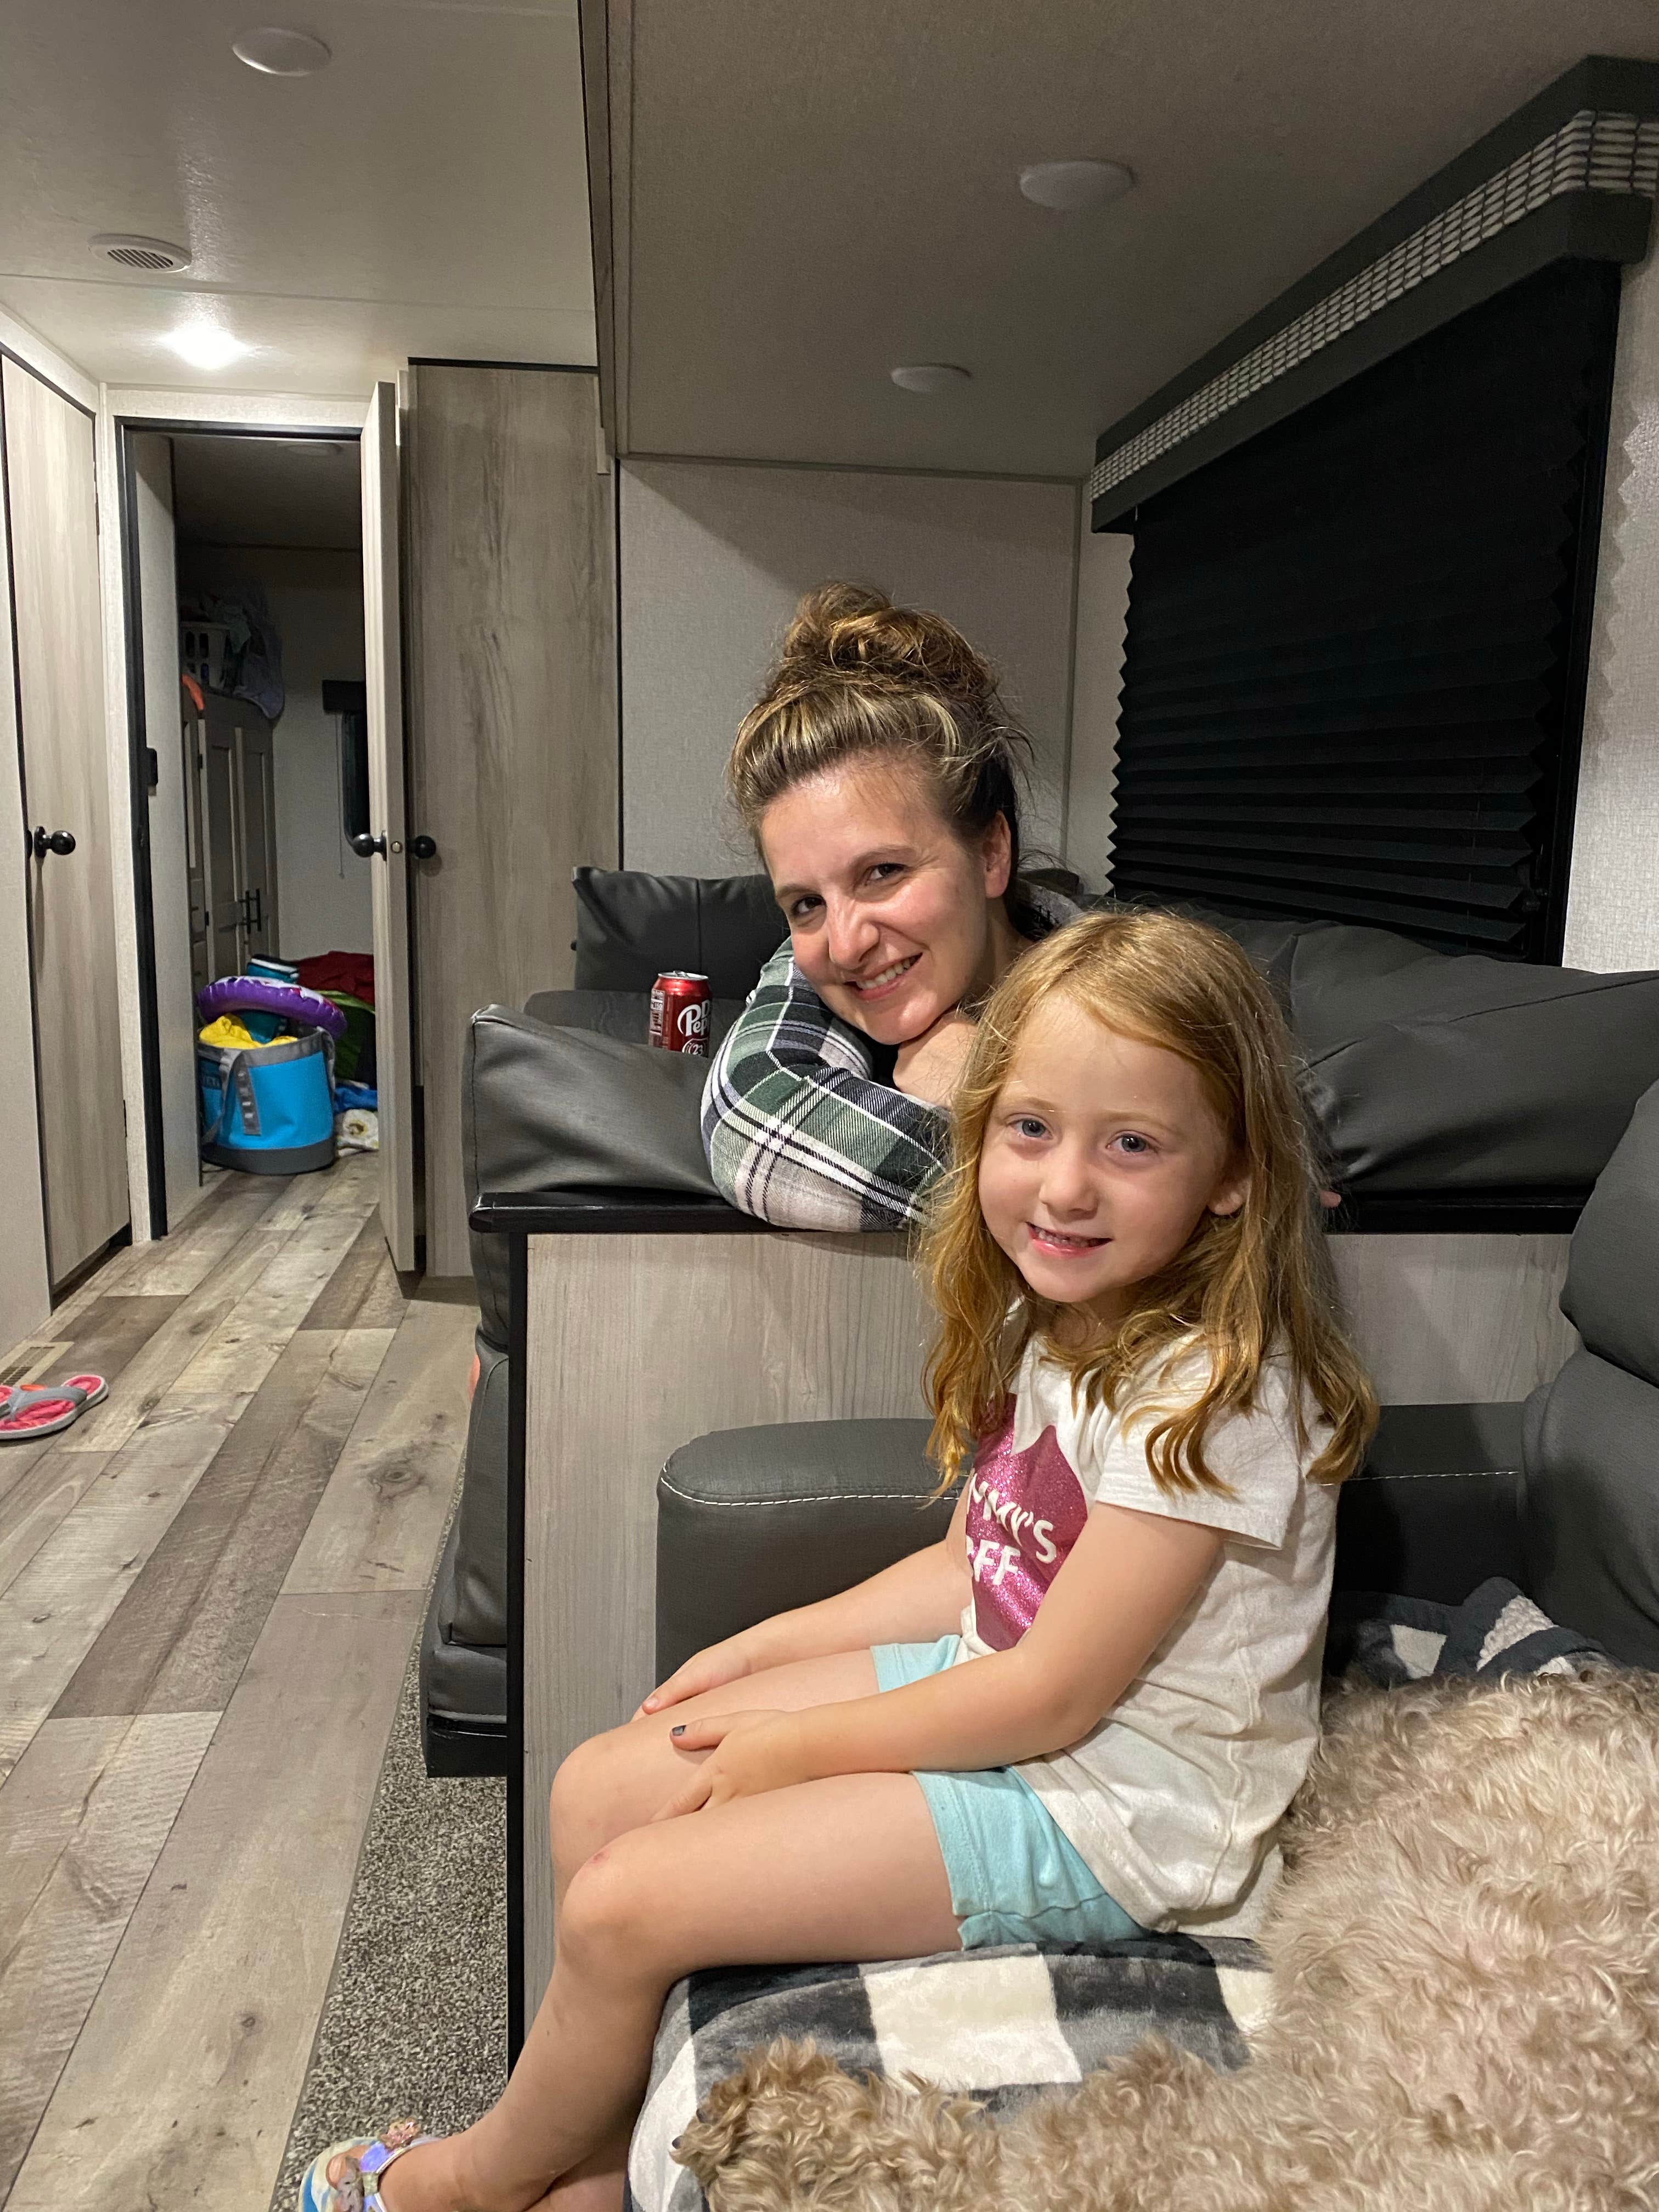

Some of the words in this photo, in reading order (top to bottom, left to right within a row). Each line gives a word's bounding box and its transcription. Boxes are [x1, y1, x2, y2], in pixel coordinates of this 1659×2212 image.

[677, 1004, 710, 1036] Pep
[692, 1045, 703, 1056] 23
[966, 1473, 1057, 1564] MMY'S
